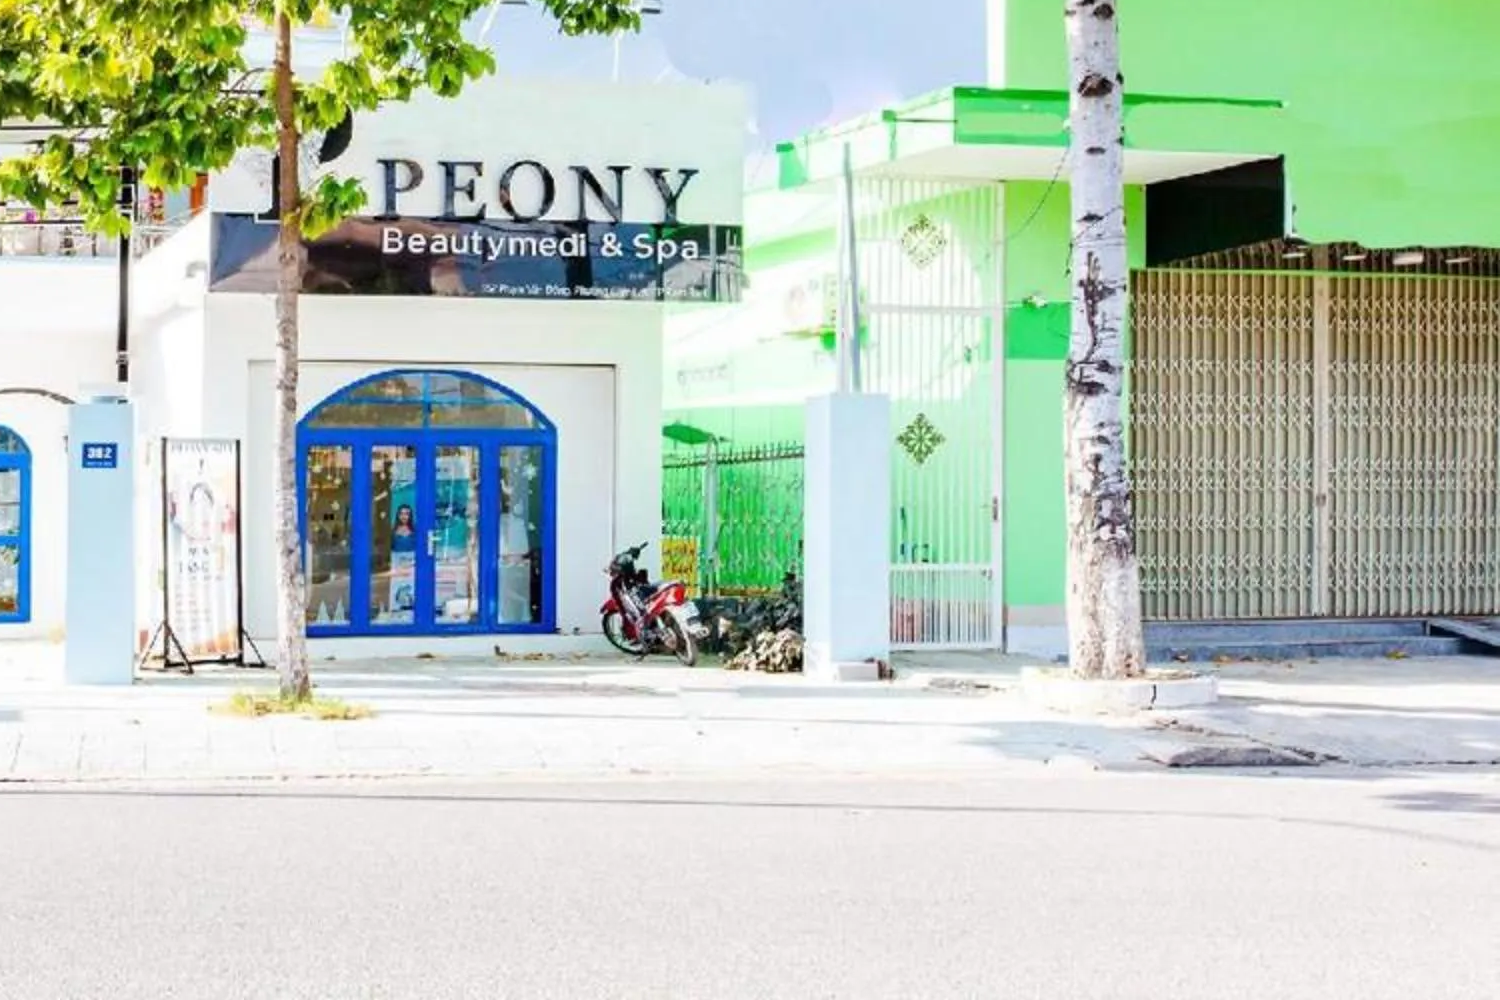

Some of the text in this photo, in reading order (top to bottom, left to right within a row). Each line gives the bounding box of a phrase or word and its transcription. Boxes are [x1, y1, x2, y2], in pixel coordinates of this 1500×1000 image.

[375, 158, 700, 227] PEONY
[382, 228, 700, 263] Beautymedi & Spa
